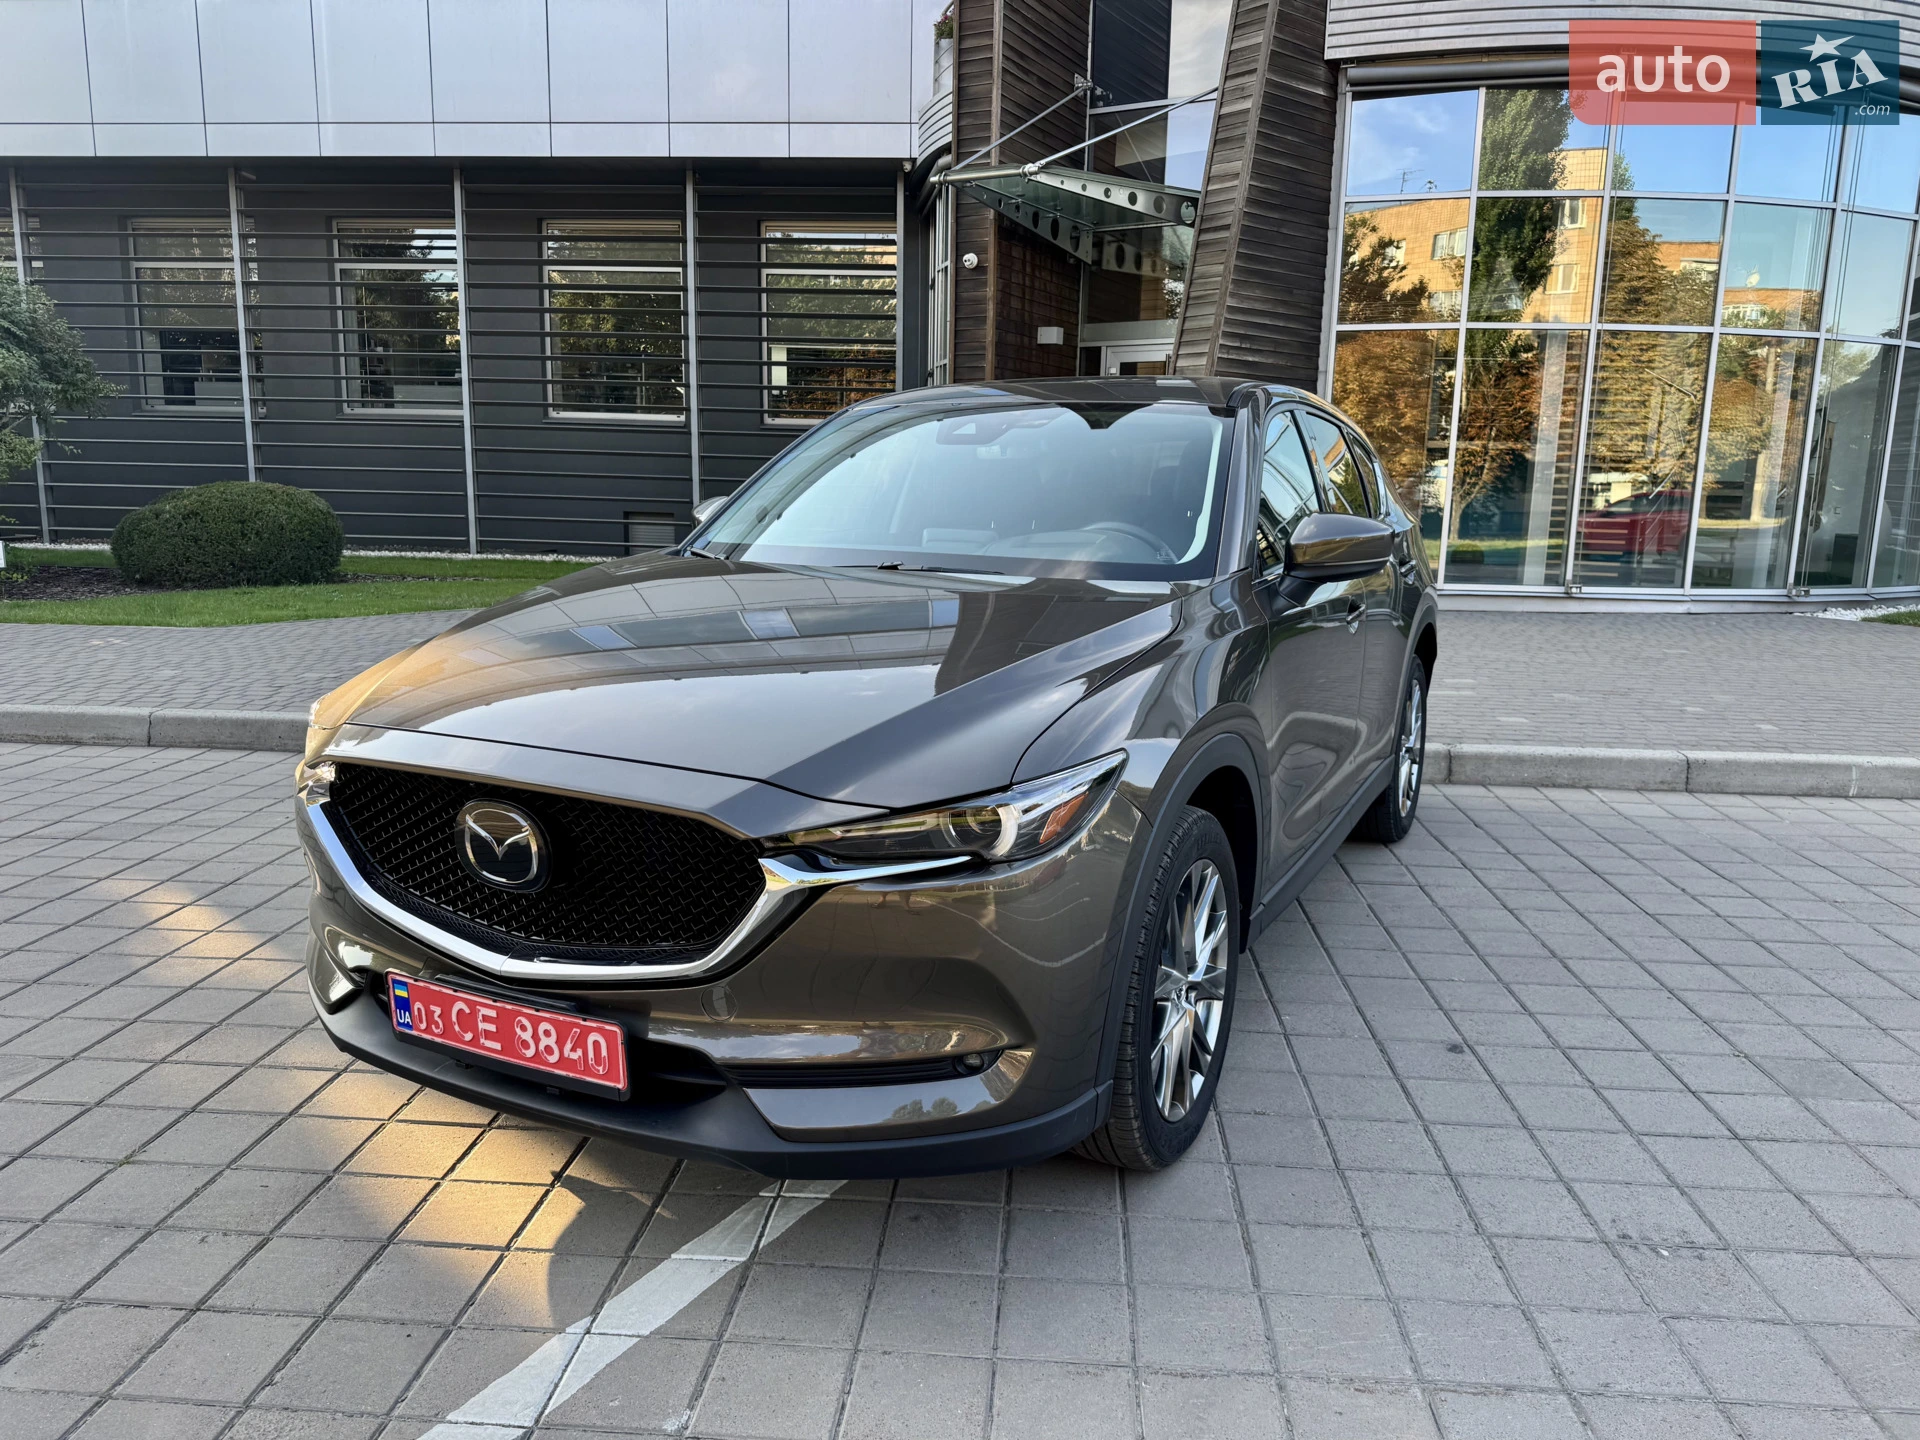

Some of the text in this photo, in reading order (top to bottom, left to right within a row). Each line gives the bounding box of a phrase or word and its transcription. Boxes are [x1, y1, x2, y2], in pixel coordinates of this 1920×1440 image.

[396, 1008, 412, 1026] UA
[413, 1001, 608, 1075] 03 CE 8840
